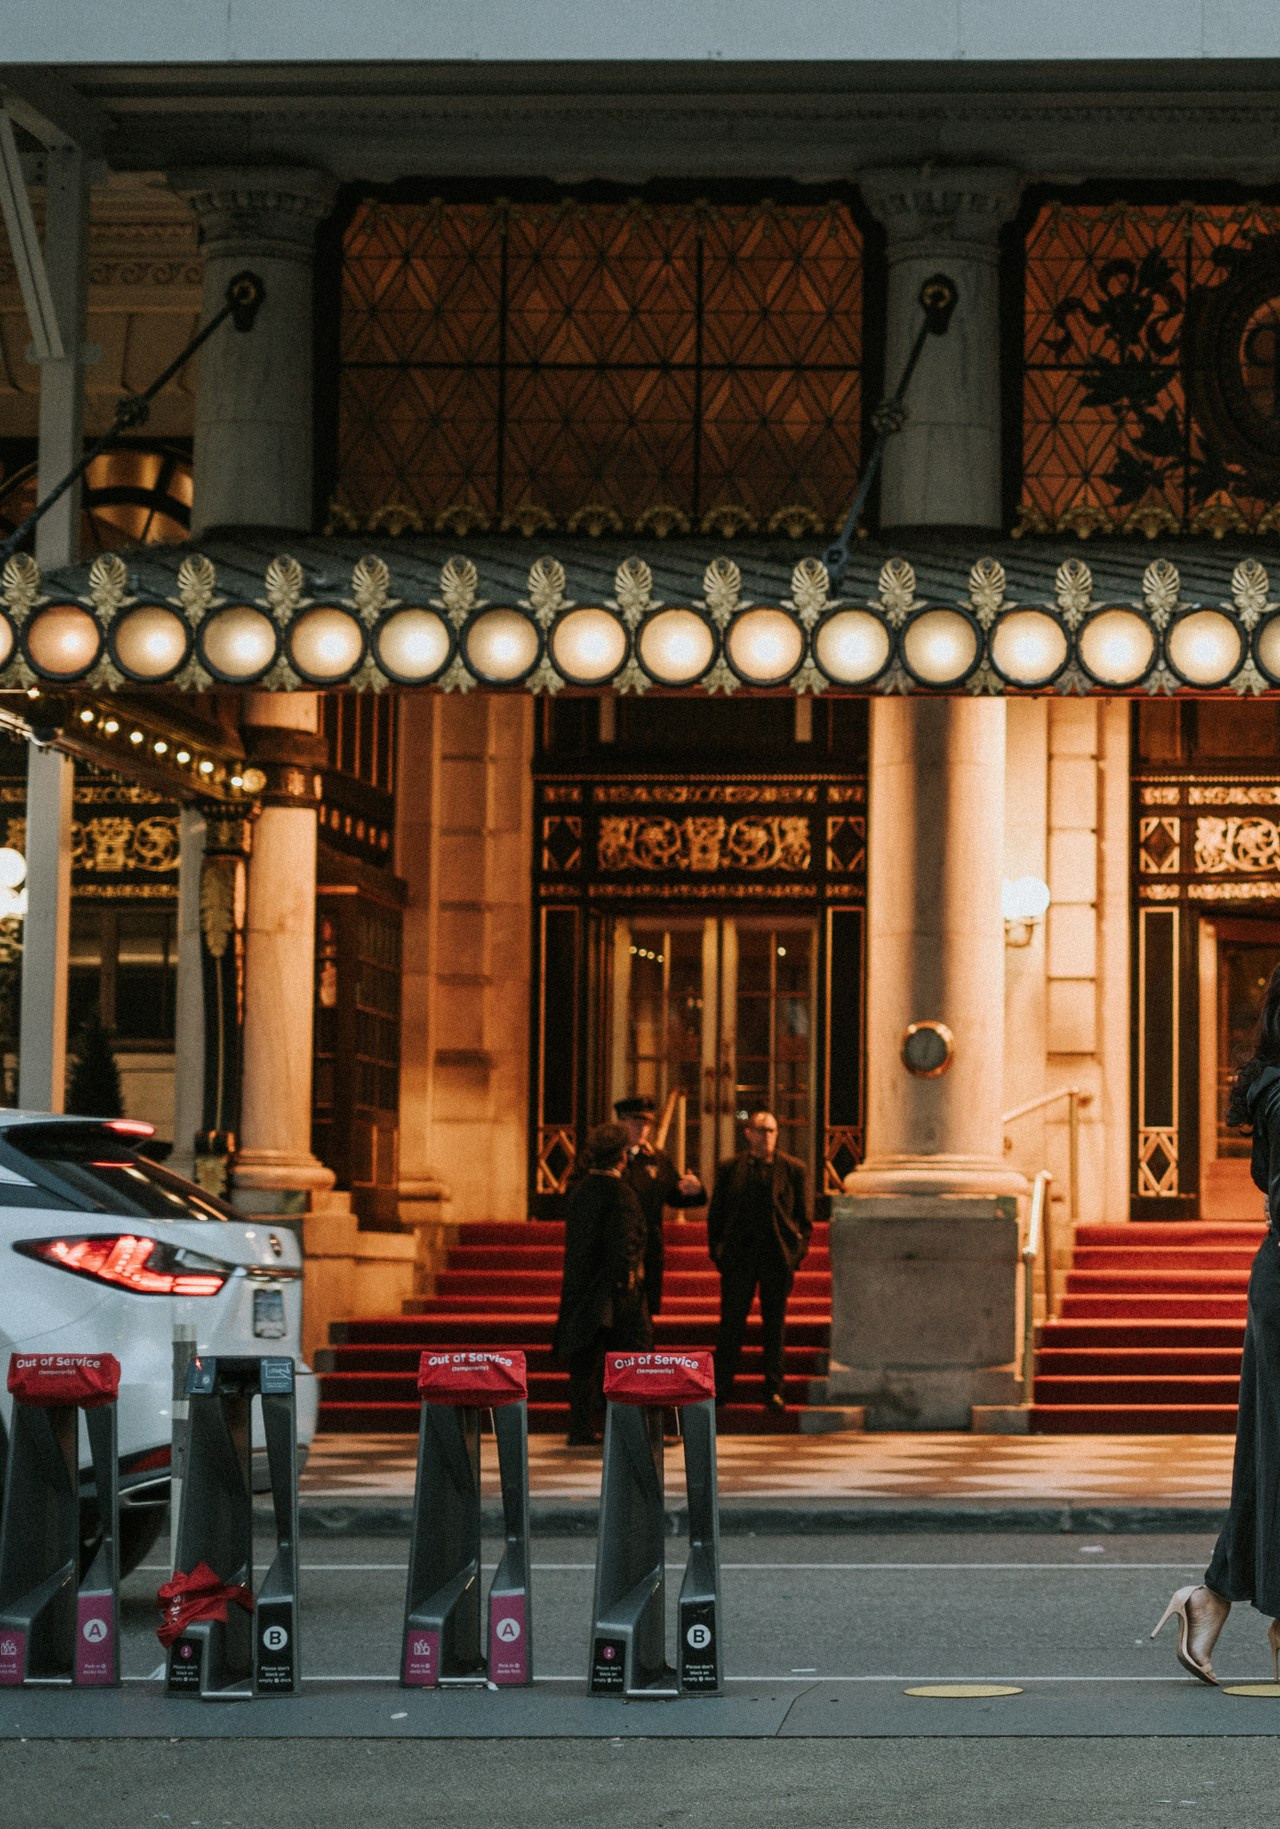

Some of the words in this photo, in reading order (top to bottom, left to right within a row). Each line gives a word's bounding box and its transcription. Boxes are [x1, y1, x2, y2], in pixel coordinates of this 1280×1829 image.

[16, 1358, 36, 1369] Out
[40, 1356, 54, 1366] of
[56, 1357, 100, 1368] Service
[428, 1354, 450, 1366] Out
[452, 1353, 466, 1363] of
[469, 1353, 513, 1367] Service
[614, 1356, 635, 1369] Out
[638, 1354, 652, 1365] of
[654, 1355, 699, 1369] Service
[88, 1623, 102, 1638] A
[502, 1623, 515, 1636] A
[693, 1629, 705, 1643] B
[270, 1631, 282, 1645] B
